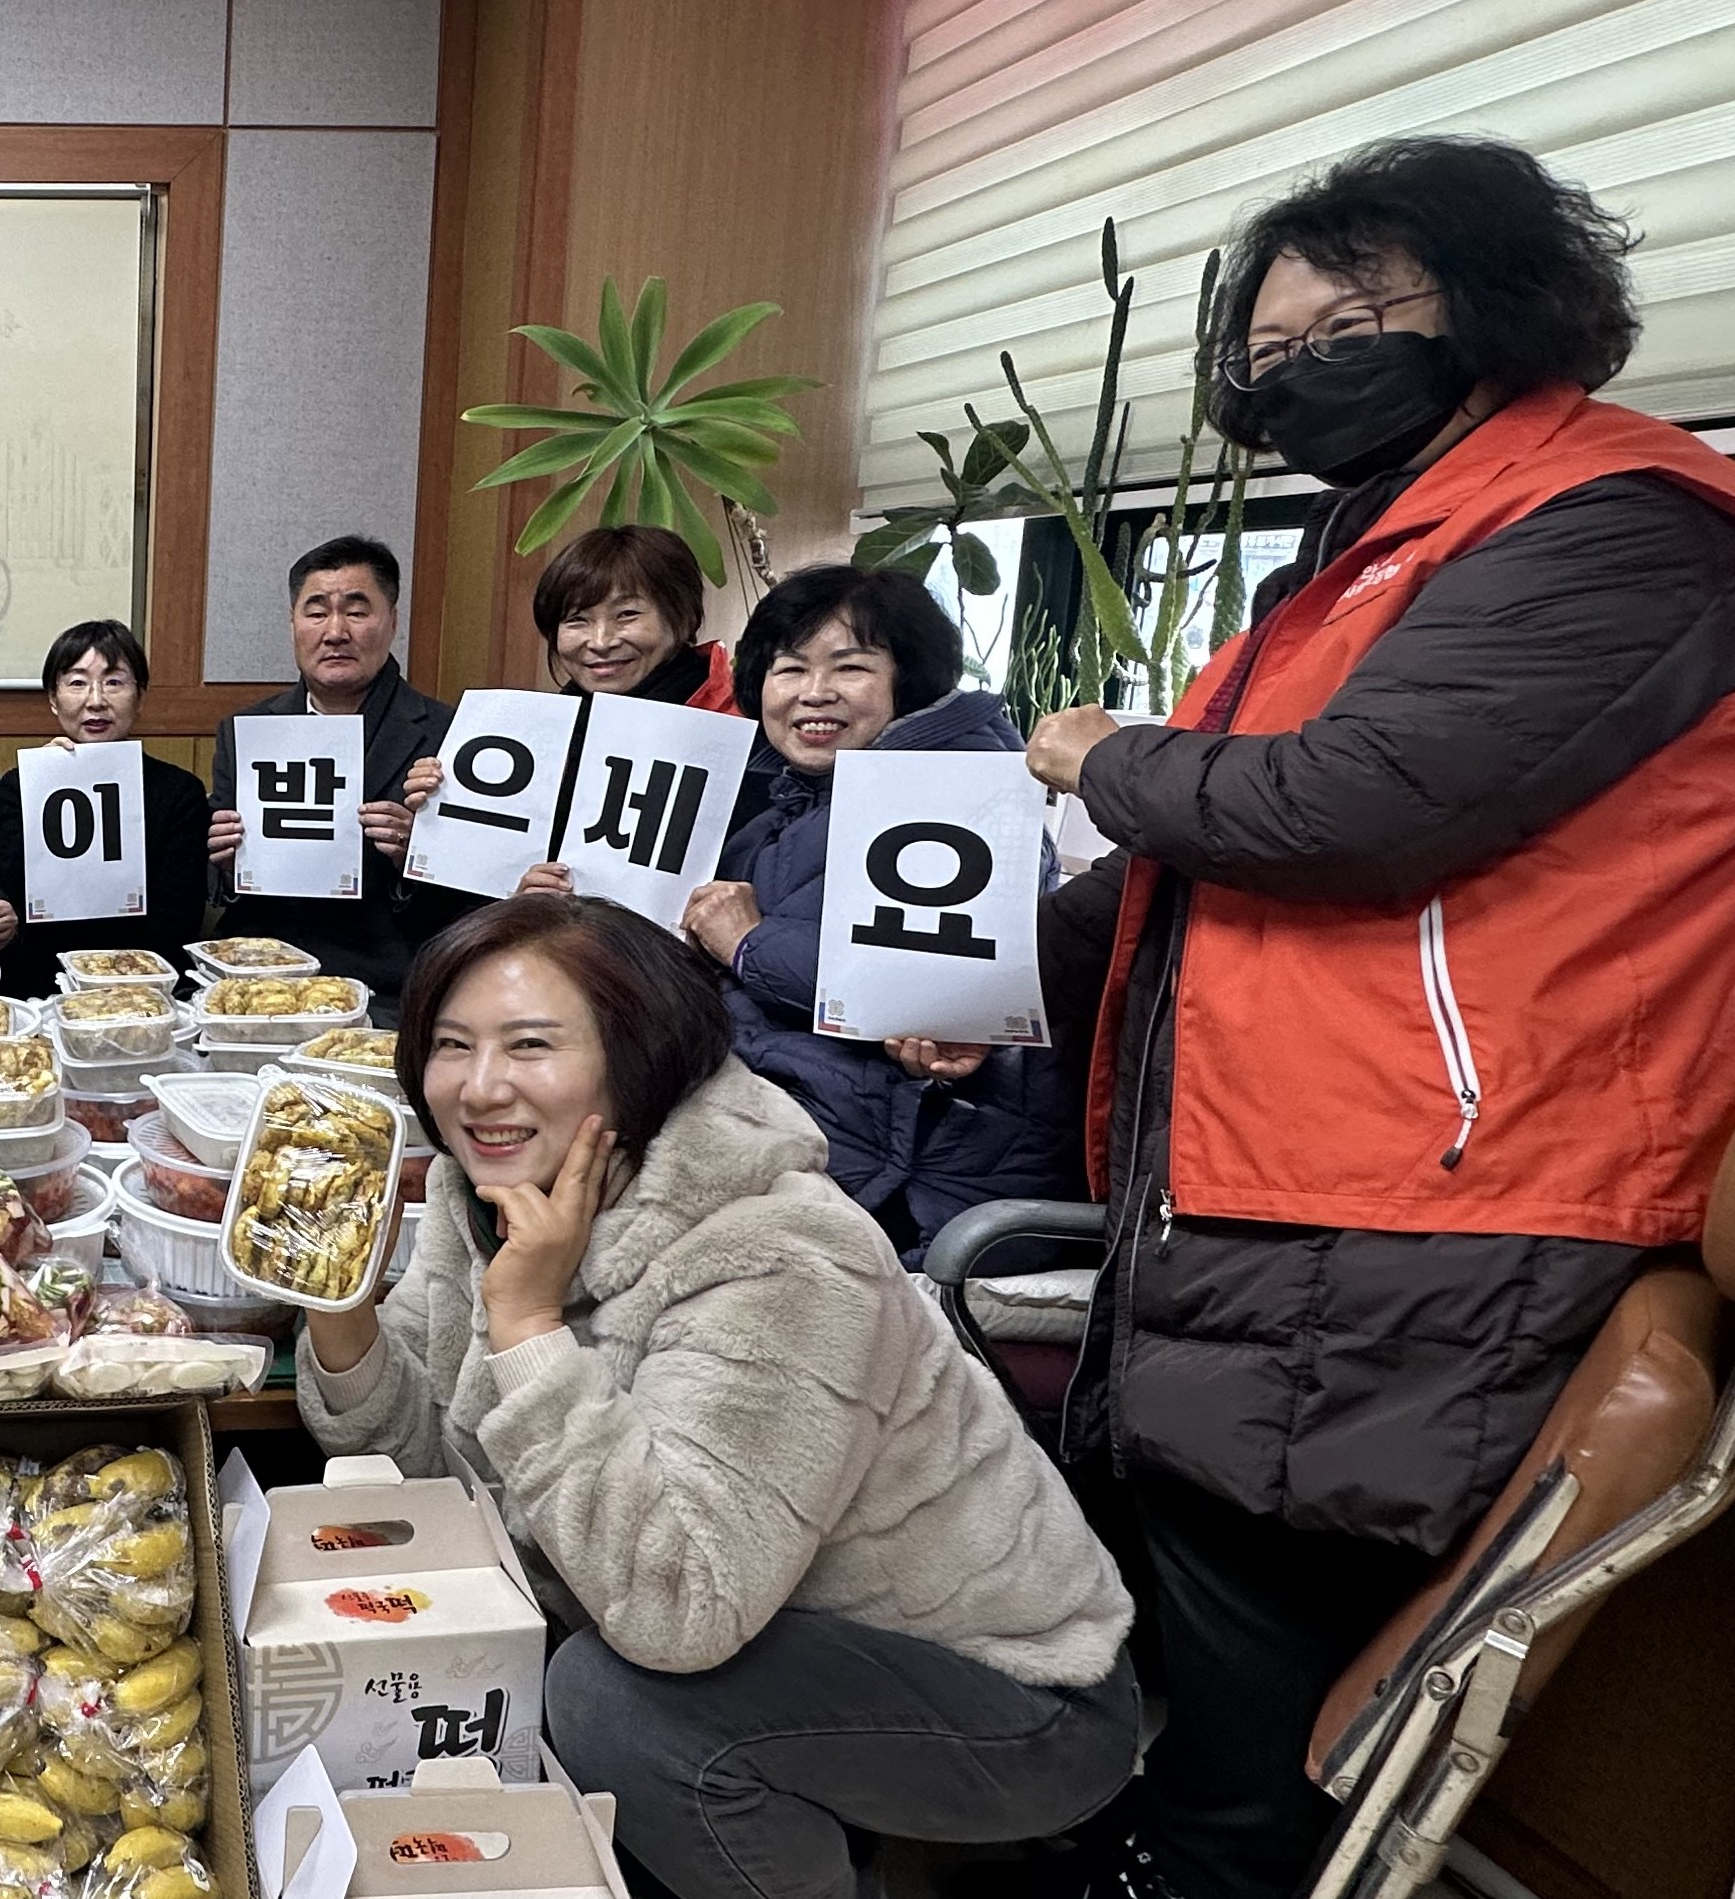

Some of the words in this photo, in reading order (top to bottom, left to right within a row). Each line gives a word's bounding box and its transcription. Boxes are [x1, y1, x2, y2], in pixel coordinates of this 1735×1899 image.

[42, 782, 123, 862] 이
[250, 757, 347, 841] 받
[437, 734, 535, 834] 으
[583, 755, 709, 876] 세
[850, 821, 997, 961] 요
[365, 1671, 423, 1704] 선물용
